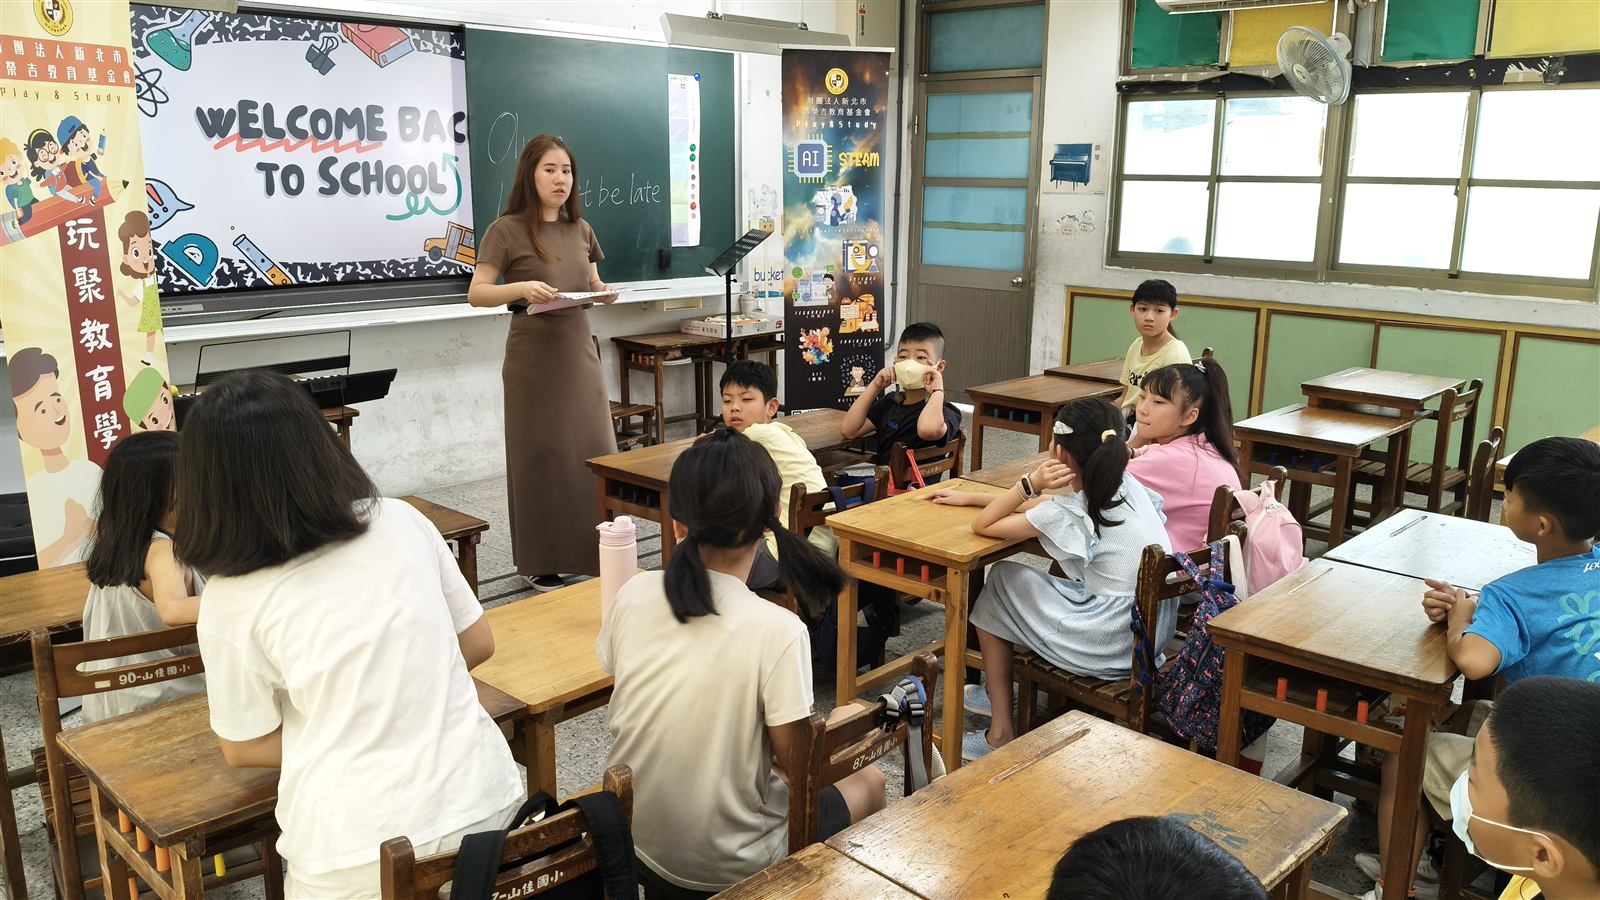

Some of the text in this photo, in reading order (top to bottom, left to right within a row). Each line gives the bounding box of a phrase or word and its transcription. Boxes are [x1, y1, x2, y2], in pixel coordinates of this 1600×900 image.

[0, 40, 122, 63] 團法人新北市
[1, 87, 121, 103] Play & Study
[197, 100, 388, 142] WELCOME
[256, 156, 448, 197] TO SCHOOL
[802, 151, 880, 168] AI STEAM
[599, 175, 625, 207] be
[629, 172, 661, 205] late
[64, 218, 123, 450] 玩聚教育學
